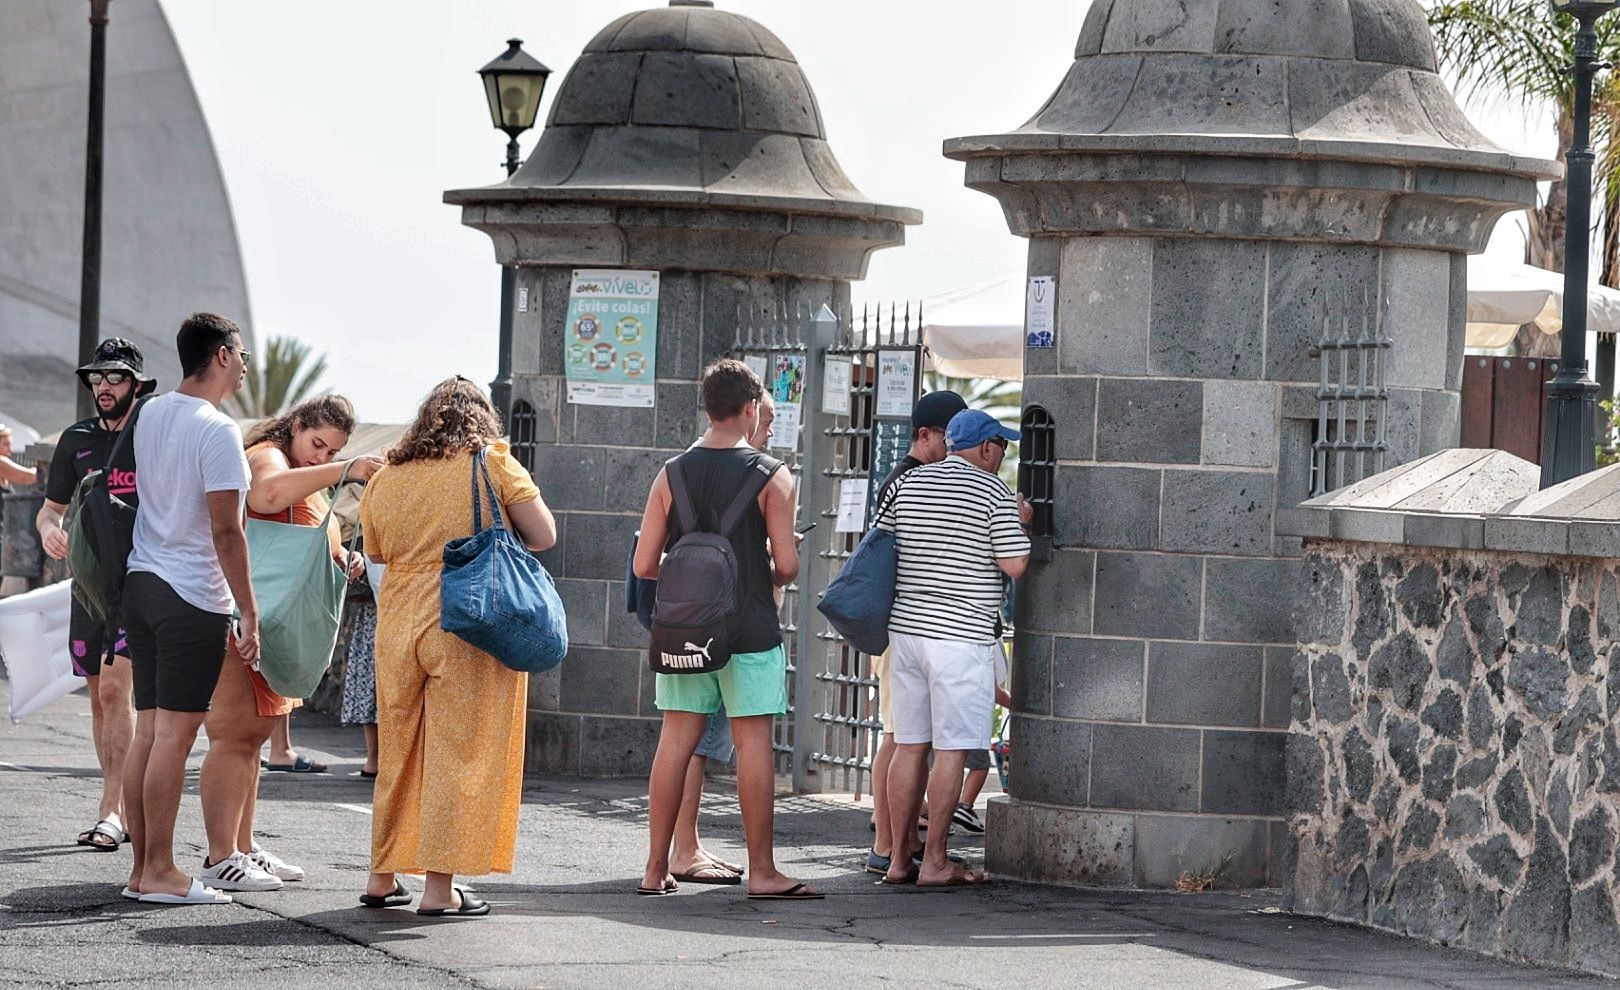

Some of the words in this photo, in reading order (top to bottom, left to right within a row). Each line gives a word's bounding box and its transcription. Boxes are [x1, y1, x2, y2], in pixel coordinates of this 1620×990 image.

[573, 300, 609, 315] ¡Evite
[611, 300, 651, 314] colas!
[661, 652, 704, 668] PUMA
